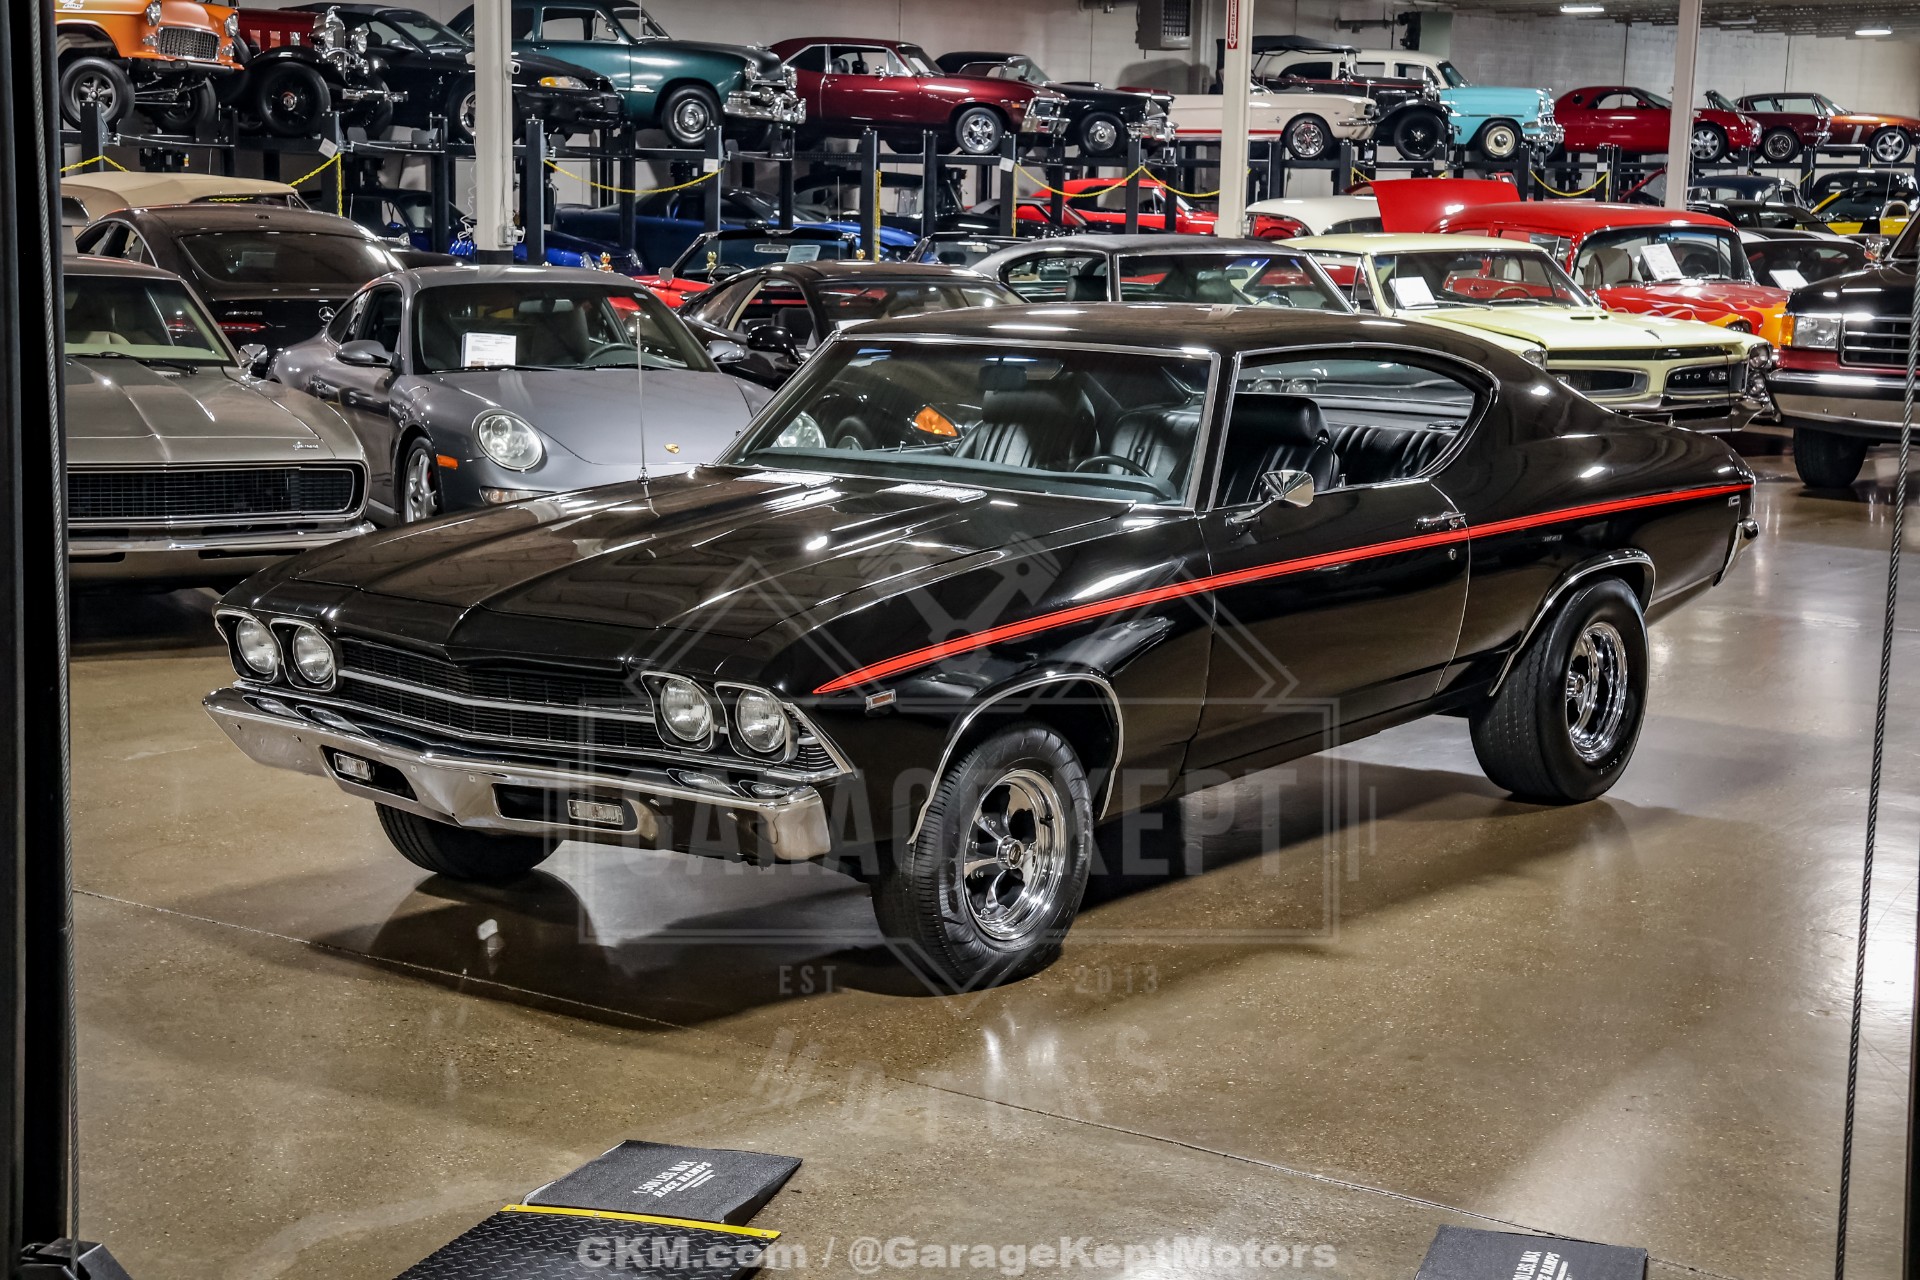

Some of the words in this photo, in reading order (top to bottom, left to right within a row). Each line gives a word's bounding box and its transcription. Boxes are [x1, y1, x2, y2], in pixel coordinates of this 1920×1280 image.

[1674, 373, 1701, 381] GTO
[667, 1160, 698, 1172] MAX
[652, 1181, 682, 1198] RACE
[676, 1161, 712, 1183] RAMPS
[1520, 1250, 1542, 1264] MAX
[1540, 1251, 1561, 1276] RAMPS
